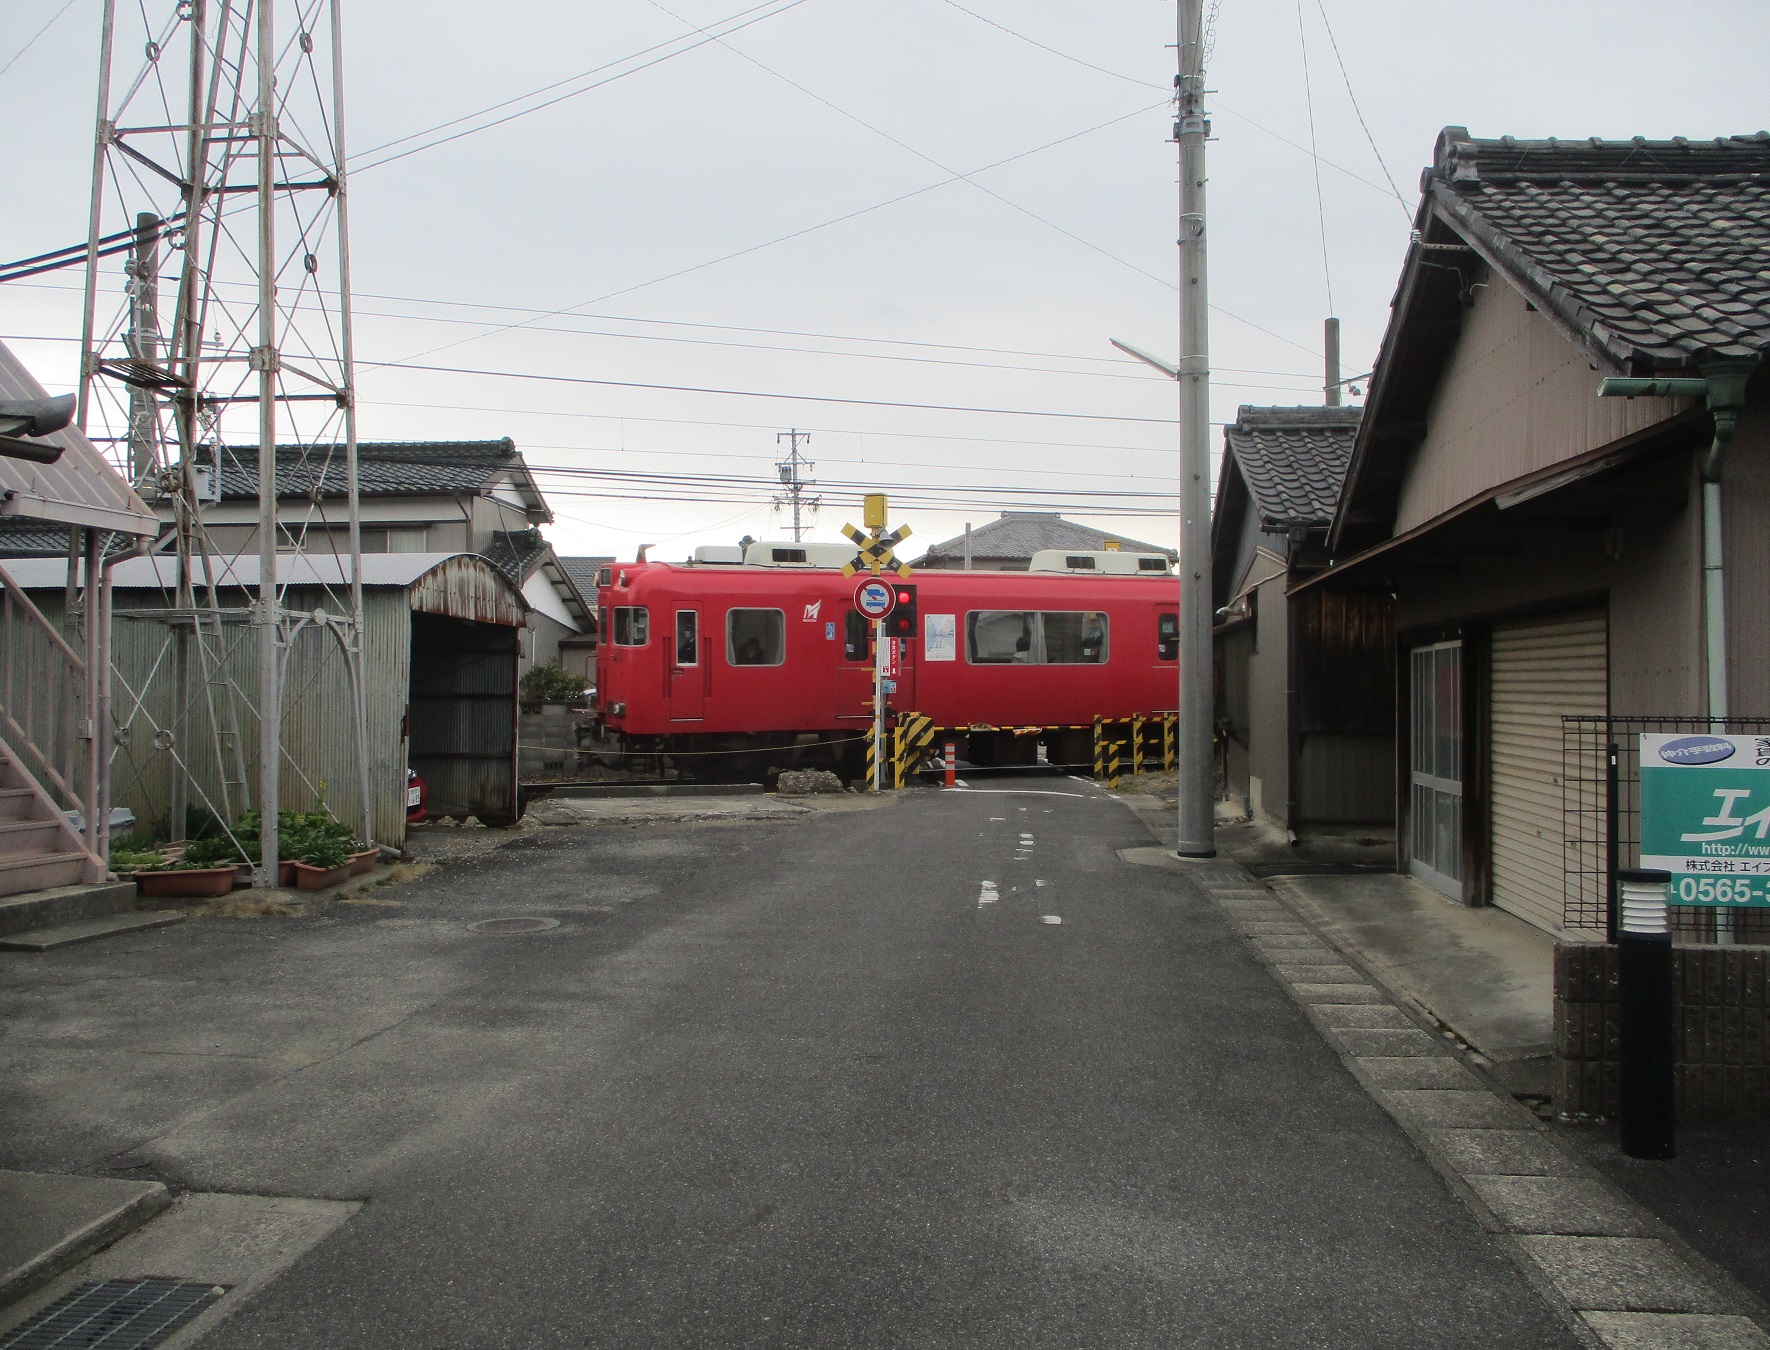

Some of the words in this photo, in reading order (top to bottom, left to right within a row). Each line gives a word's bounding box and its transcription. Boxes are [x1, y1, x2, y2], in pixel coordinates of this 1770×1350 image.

[1685, 859, 1735, 872] 株式会社
[1680, 878, 1770, 902] 0565-
